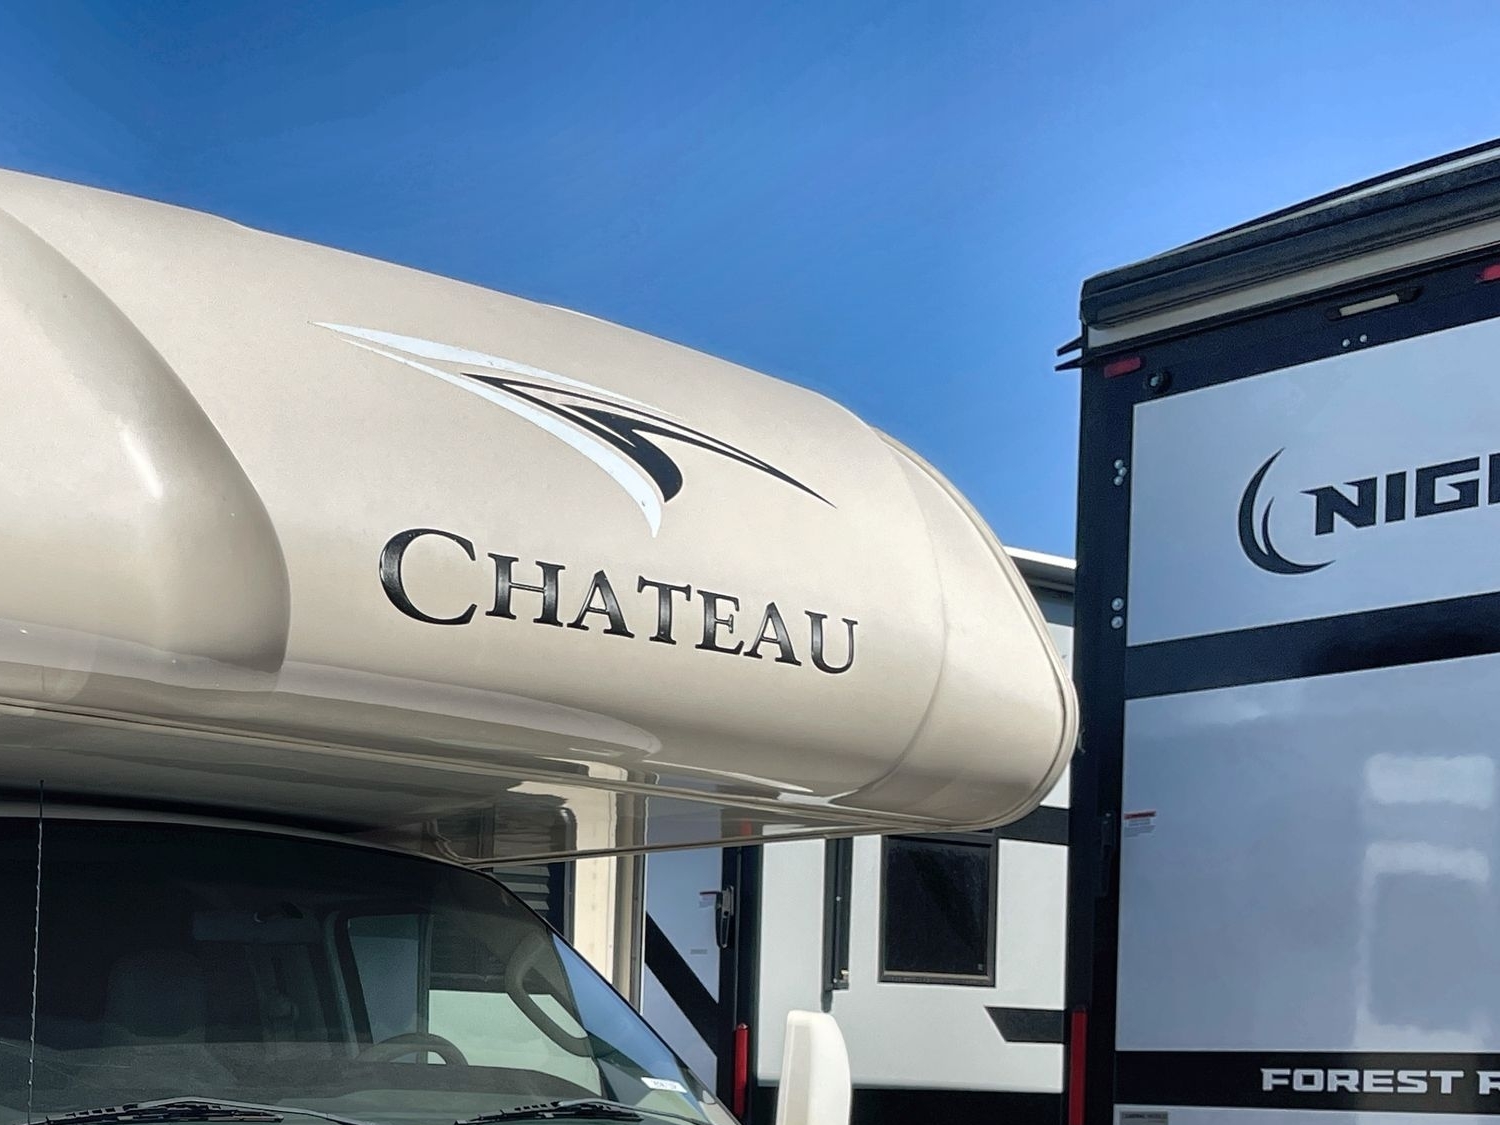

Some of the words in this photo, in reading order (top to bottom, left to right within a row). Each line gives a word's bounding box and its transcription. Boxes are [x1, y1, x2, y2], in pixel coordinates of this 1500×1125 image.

[1300, 453, 1500, 536] NIG
[378, 527, 859, 675] CHATEAU
[1260, 1067, 1464, 1095] FOREST
